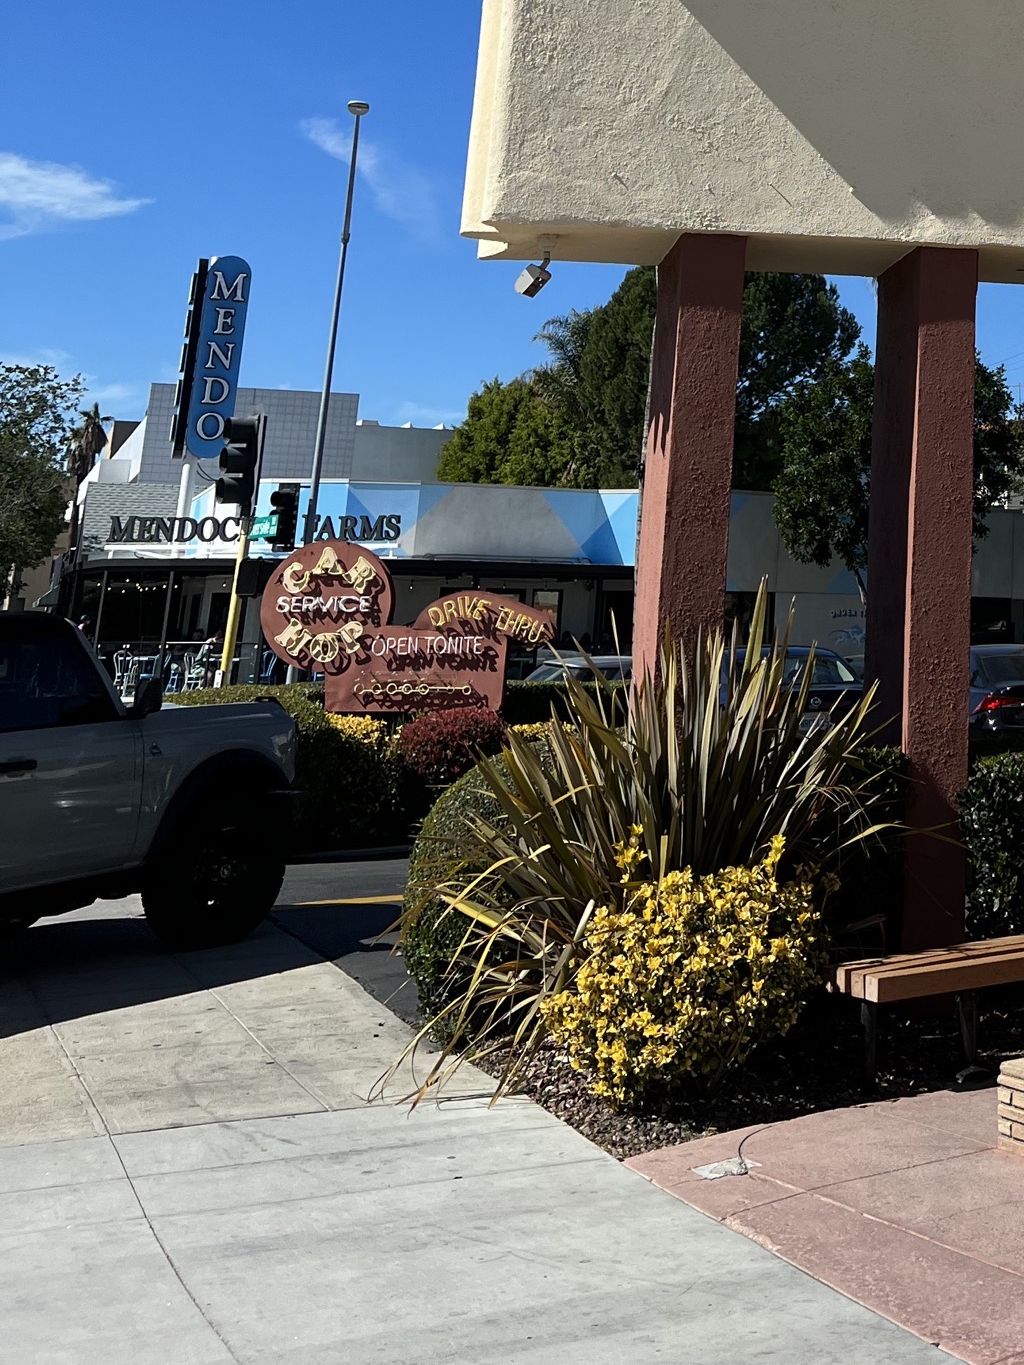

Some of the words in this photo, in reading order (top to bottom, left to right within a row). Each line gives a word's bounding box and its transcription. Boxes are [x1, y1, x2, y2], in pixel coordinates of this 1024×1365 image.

[196, 271, 247, 440] MENDO
[106, 515, 246, 543] MENDOC
[283, 547, 376, 595] CAR
[276, 595, 372, 614] SERVICE
[428, 596, 491, 626] DRIVE
[495, 605, 544, 643] THRU
[276, 618, 364, 663] HOP
[371, 635, 418, 656] OPEN
[425, 636, 483, 655] TONITE
